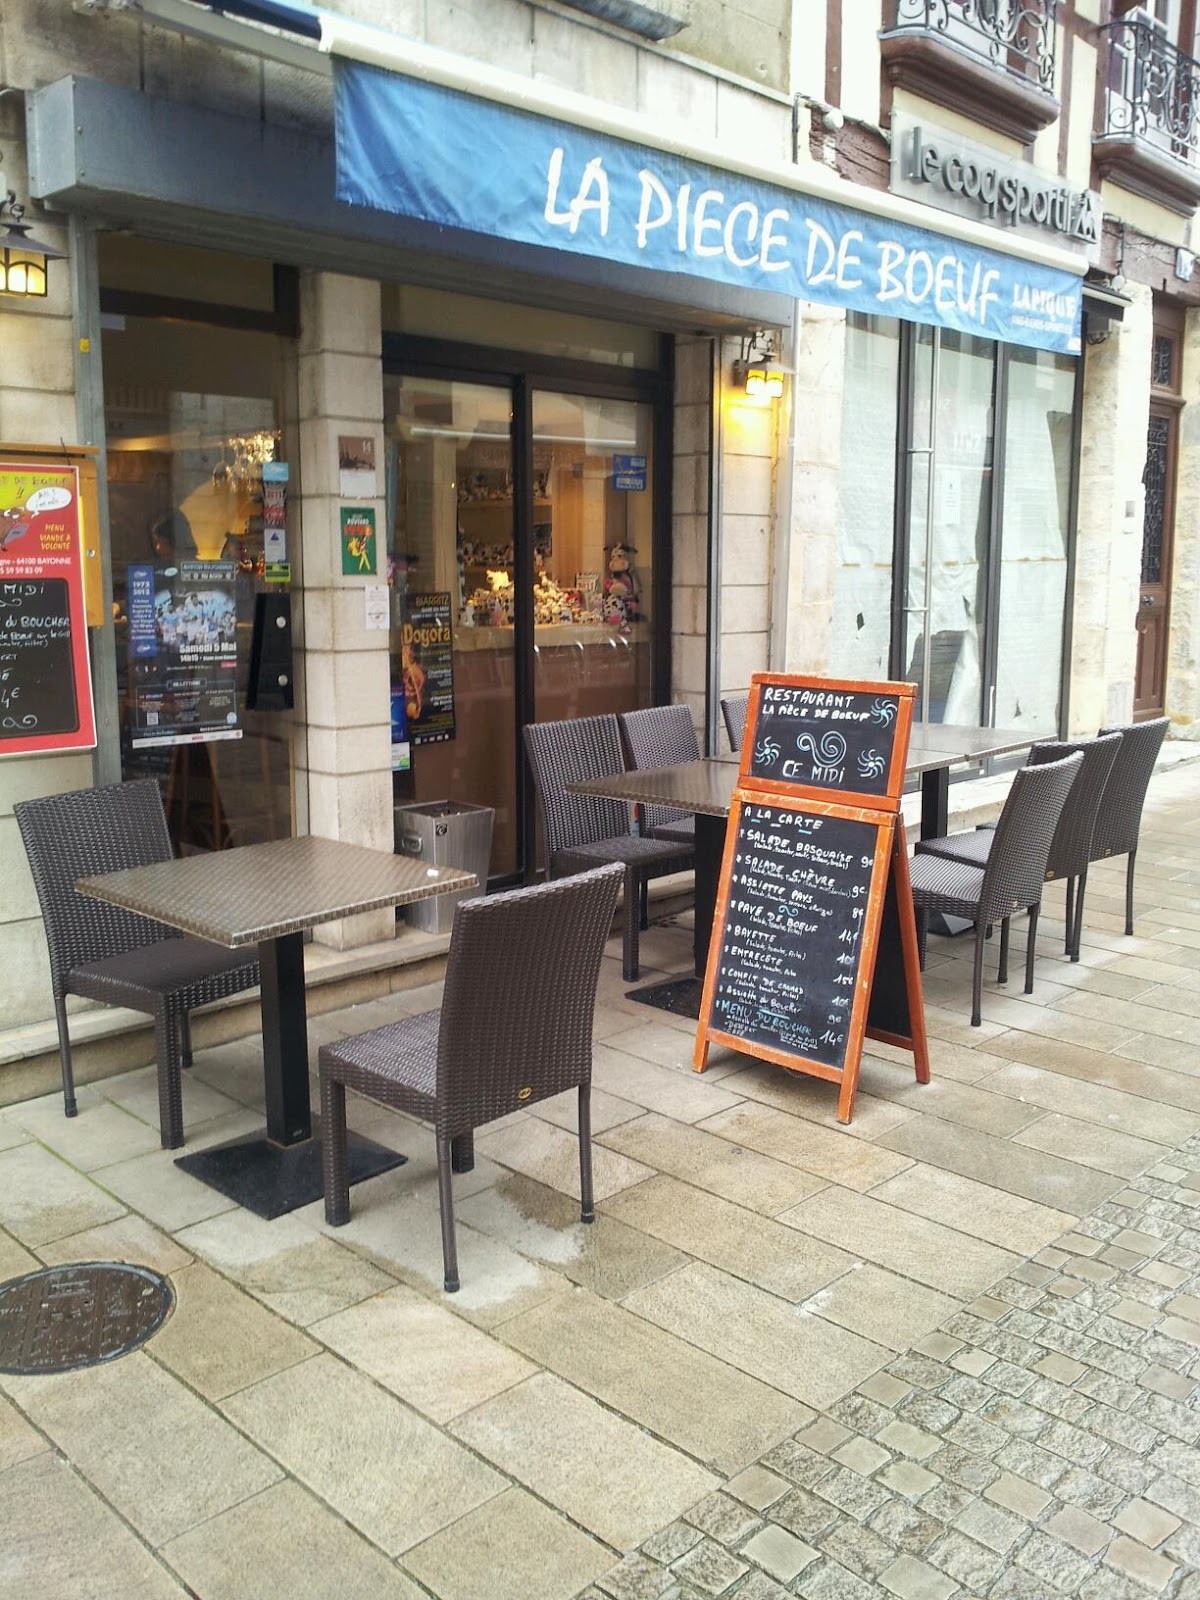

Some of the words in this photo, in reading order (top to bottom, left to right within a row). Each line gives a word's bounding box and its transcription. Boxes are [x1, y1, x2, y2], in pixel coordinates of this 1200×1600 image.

[913, 126, 941, 183] le
[942, 153, 1000, 219] coq
[1001, 175, 1076, 234] sportif
[544, 147, 610, 236] LA
[635, 168, 791, 271] PIECE
[805, 217, 864, 290] DE
[876, 240, 1000, 325] BOEUF
[37, 557, 71, 565] BAYONNE
[764, 687, 855, 708] RESTAURANT
[762, 704, 774, 715] LA
[814, 709, 829, 719] DE
[831, 709, 871, 722] BOEUF
[744, 806, 751, 817] A
[757, 808, 771, 820] LA
[778, 813, 823, 830] CARTE
[746, 828, 790, 848] SALADE
[744, 854, 784, 872] SALADE
[791, 889, 813, 904] PAYS
[786, 917, 818, 932] BOEUF
[727, 968, 758, 982] CONFIT
[721, 999, 752, 1018] MENU
[756, 1011, 771, 1024] DU
[772, 1017, 811, 1036] BOUCHER
[820, 1029, 844, 1046] 14€
